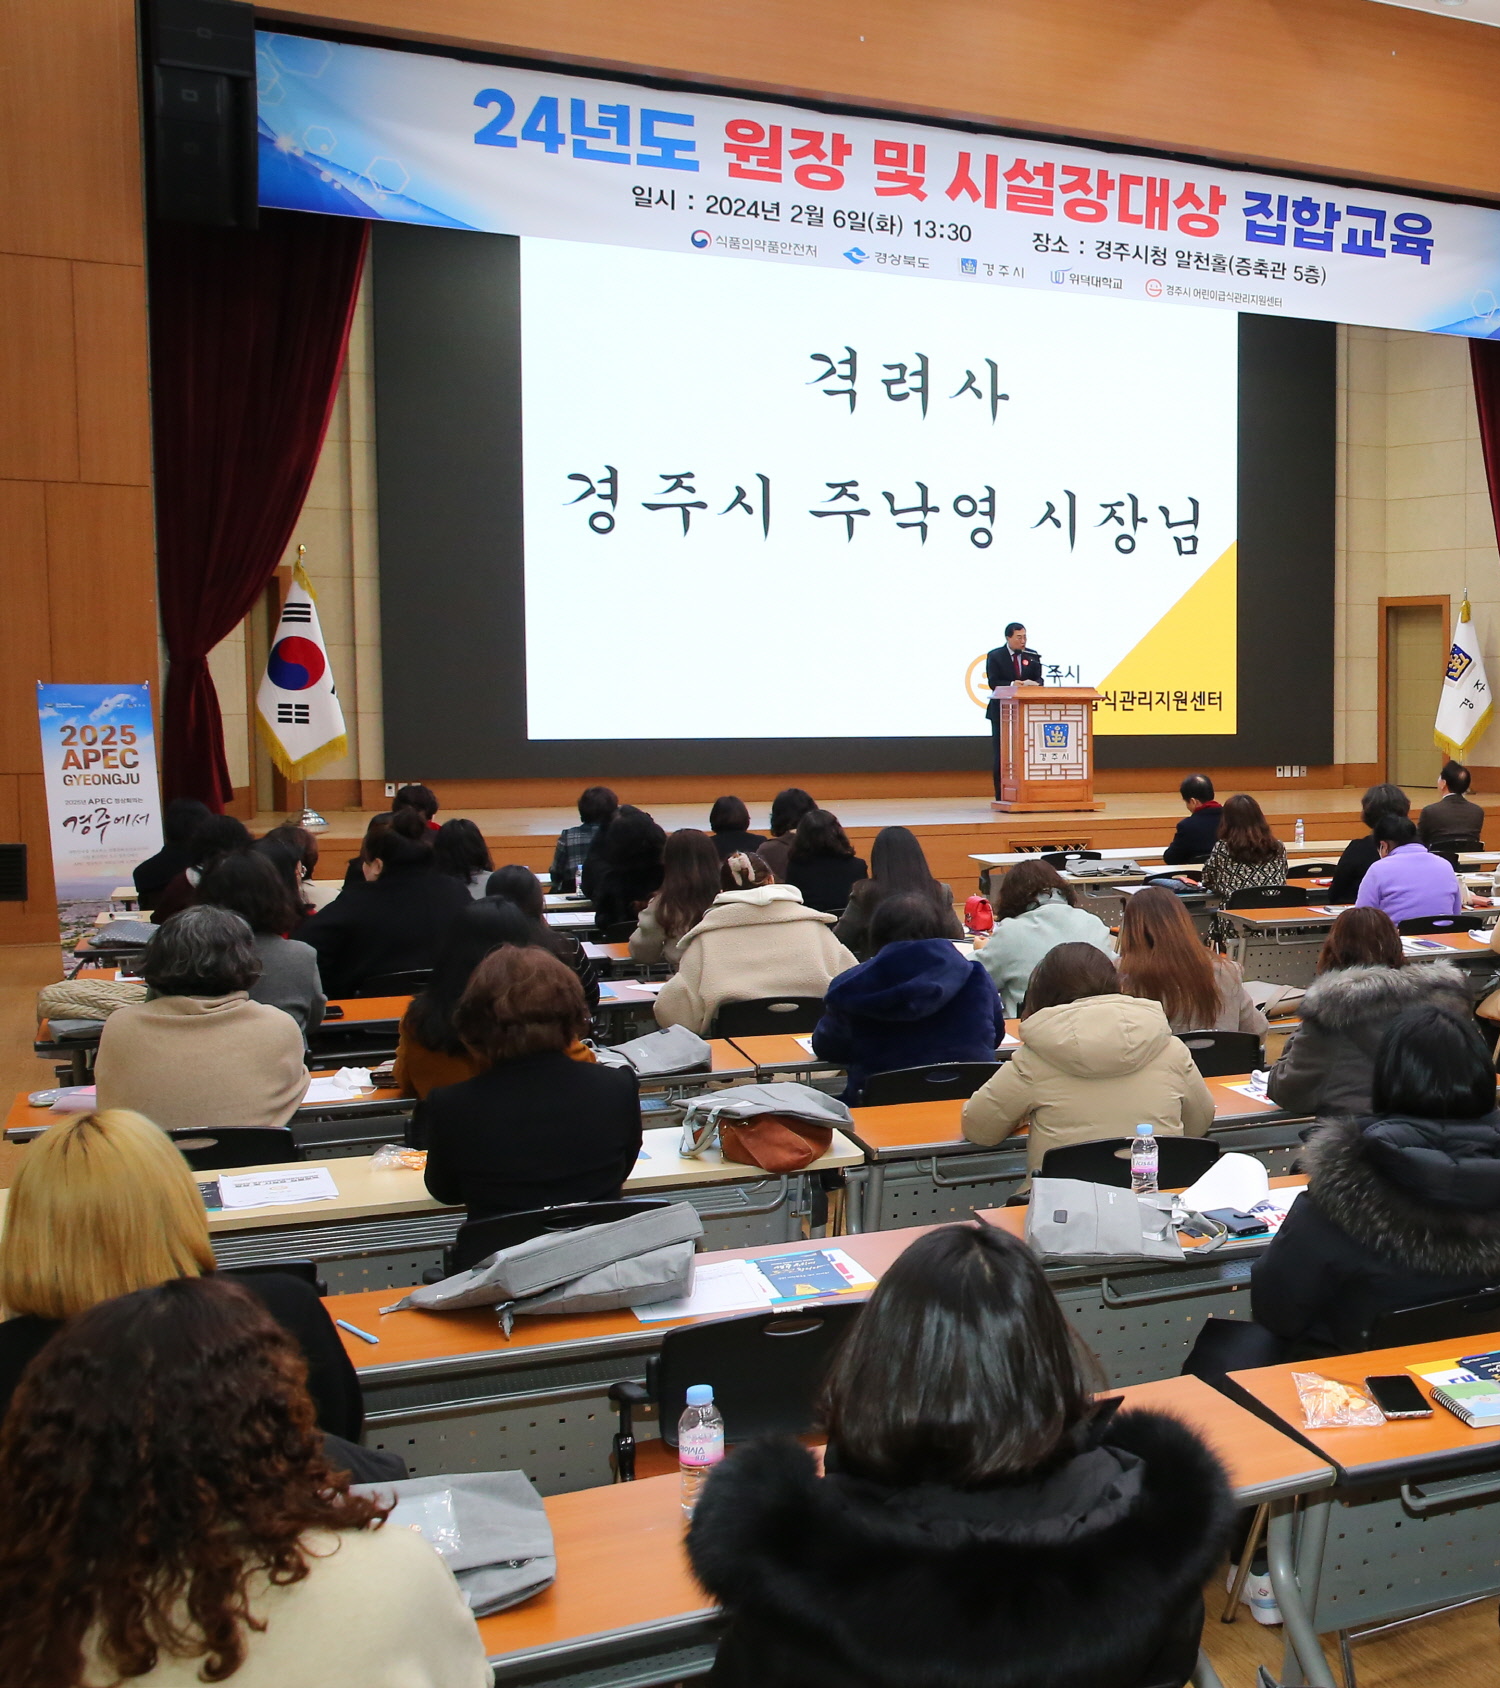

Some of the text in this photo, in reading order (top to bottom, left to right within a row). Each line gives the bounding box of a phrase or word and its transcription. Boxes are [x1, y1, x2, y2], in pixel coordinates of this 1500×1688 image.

[473, 88, 1435, 266] 24년도 원장 및 시설장대상 집합교육
[631, 186, 676, 210] 일시
[705, 195, 781, 222] 2024년
[790, 204, 824, 228] 2월
[833, 210, 903, 237] 6일(화)
[913, 219, 972, 243] 13:30
[715, 235, 818, 258] 식품의약품안전처
[874, 251, 930, 270] 경상북도
[1032, 233, 1070, 254] 장소
[1095, 239, 1167, 266] 경주시청
[1175, 250, 1287, 281] 알천홀(증축관
[1293, 264, 1327, 286] 5층)
[1069, 273, 1123, 290] 위덕대학교
[1166, 284, 1283, 308] 경주시 어린이급식관리지원센터
[805, 346, 1010, 426] 격려사
[562, 465, 1201, 557] 경주시 주낙영 시장님
[1046, 665, 1080, 684] 주시
[59, 724, 137, 746] 2025
[61, 748, 139, 771] APEC
[63, 773, 140, 786] GYEONGJU
[88, 797, 113, 805] APEC
[62, 808, 150, 845] 경주에서
